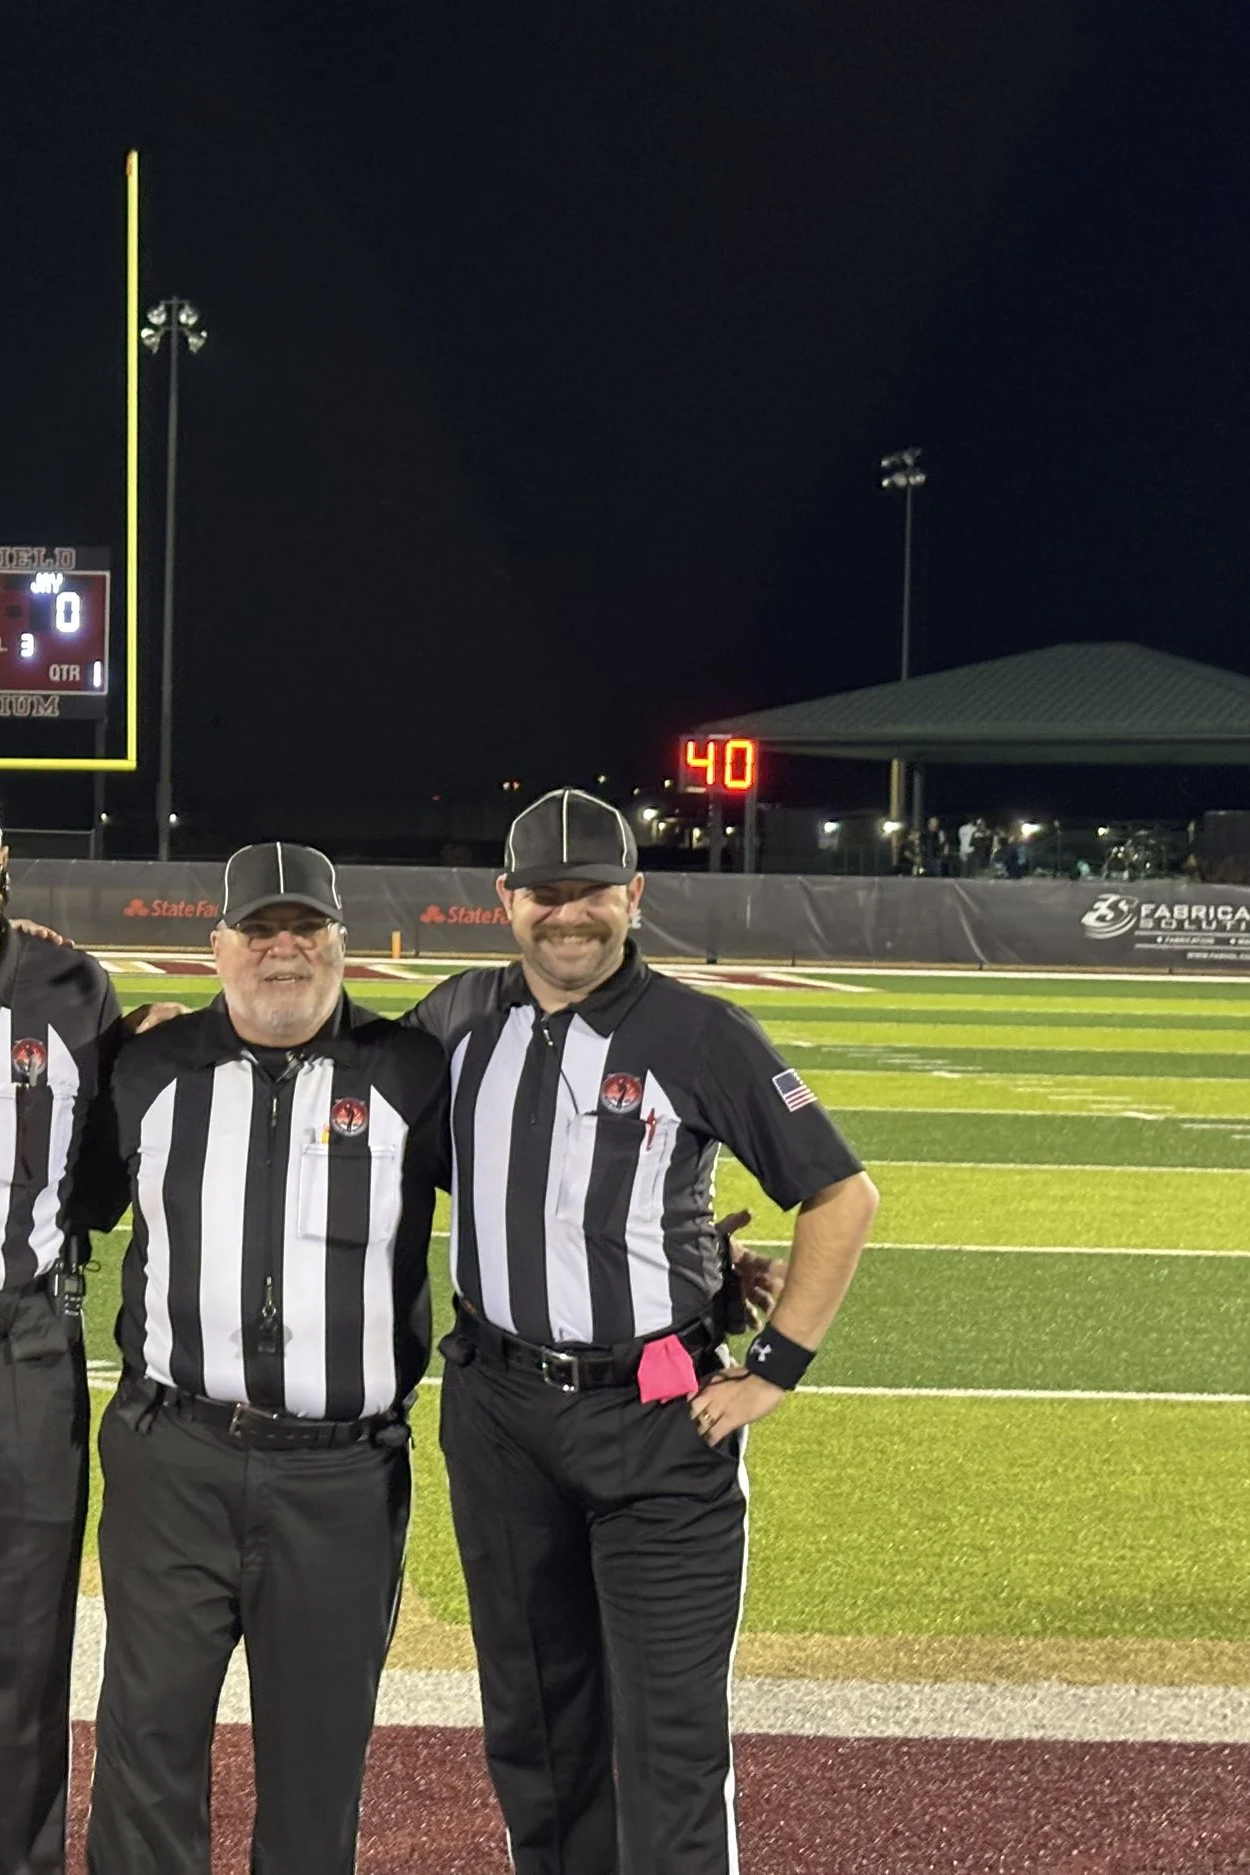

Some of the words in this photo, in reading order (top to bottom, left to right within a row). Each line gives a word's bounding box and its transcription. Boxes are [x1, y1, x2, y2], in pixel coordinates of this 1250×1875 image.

[55, 591, 81, 633] 0
[20, 632, 35, 657] 3
[49, 664, 81, 682] QTR
[686, 738, 754, 790] 40
[1139, 903, 1250, 921] FABRICA
